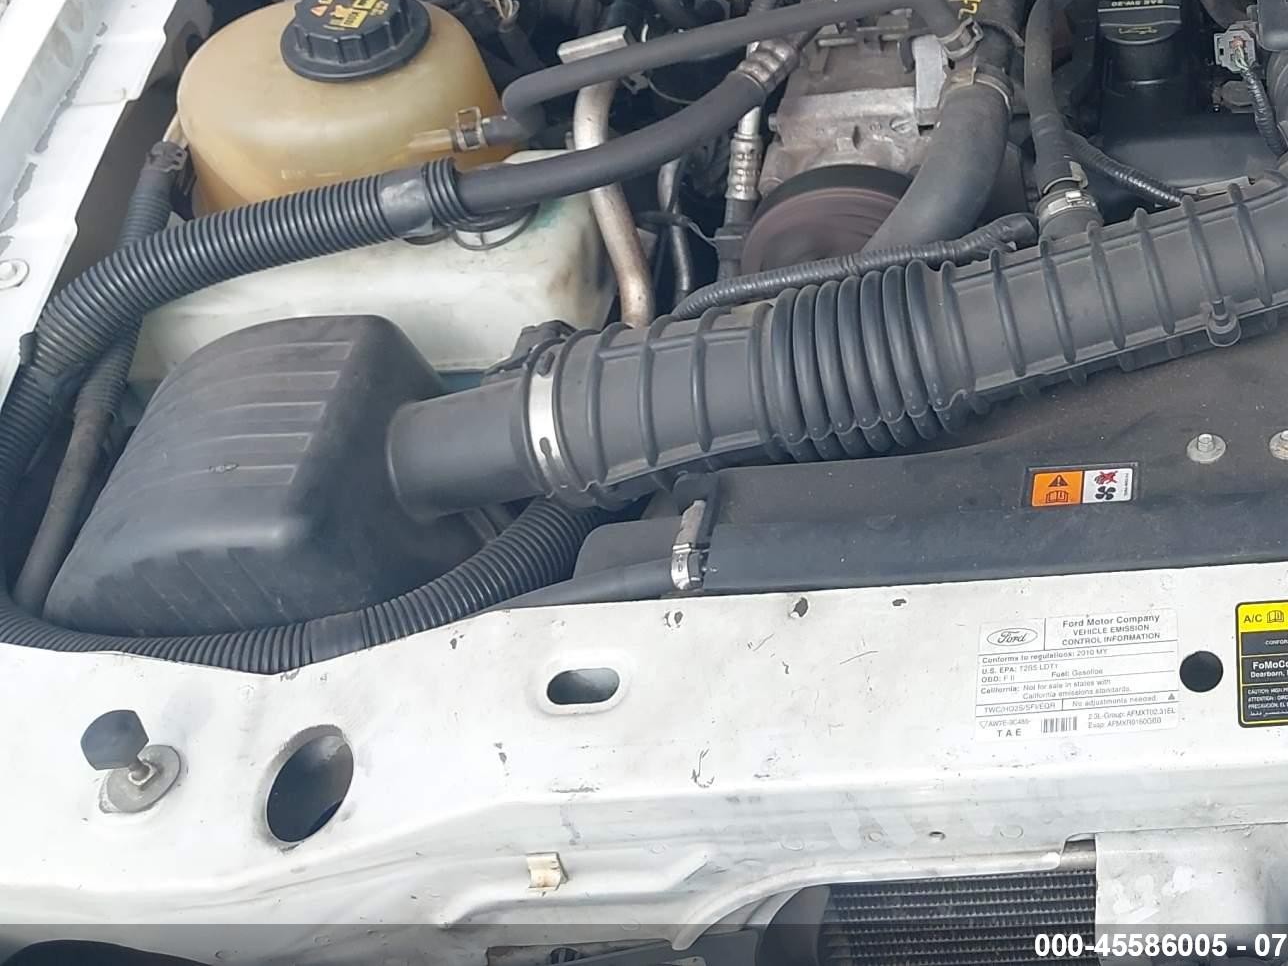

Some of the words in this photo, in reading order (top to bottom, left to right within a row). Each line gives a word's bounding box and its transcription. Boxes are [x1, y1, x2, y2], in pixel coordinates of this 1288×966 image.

[1062, 619, 1084, 629] Ford
[1086, 617, 1114, 627] Motor
[1116, 613, 1160, 624] Company
[1243, 614, 1263, 623] A/C
[1073, 627, 1107, 636] VEHICLE
[1110, 624, 1150, 634] EMISSION
[997, 630, 1027, 644] Ford
[1061, 636, 1102, 646] CONTROL
[1103, 632, 1160, 643] INFORMATION
[982, 656, 1018, 664] Conforms
[1030, 651, 1075, 661] regulations:
[1076, 648, 1094, 656] 2010
[982, 666, 997, 674] U.S.
[1000, 664, 1016, 673] EPA:
[1051, 670, 1070, 678] Fuel:
[1072, 668, 1103, 676] Gasoline
[1250, 670, 1285, 678] Dearborn,
[980, 685, 1020, 694] California:
[1023, 683, 1035, 691] Not
[1037, 682, 1047, 690] for
[1049, 681, 1062, 689] sale
[1073, 679, 1094, 687] states
[1096, 678, 1111, 686] with
[1022, 691, 1056, 700] California
[1058, 689, 1094, 697] emissions
[1084, 697, 1128, 706] adjustments
[997, 729, 1003, 737] T
[1015, 728, 1022, 736] E
